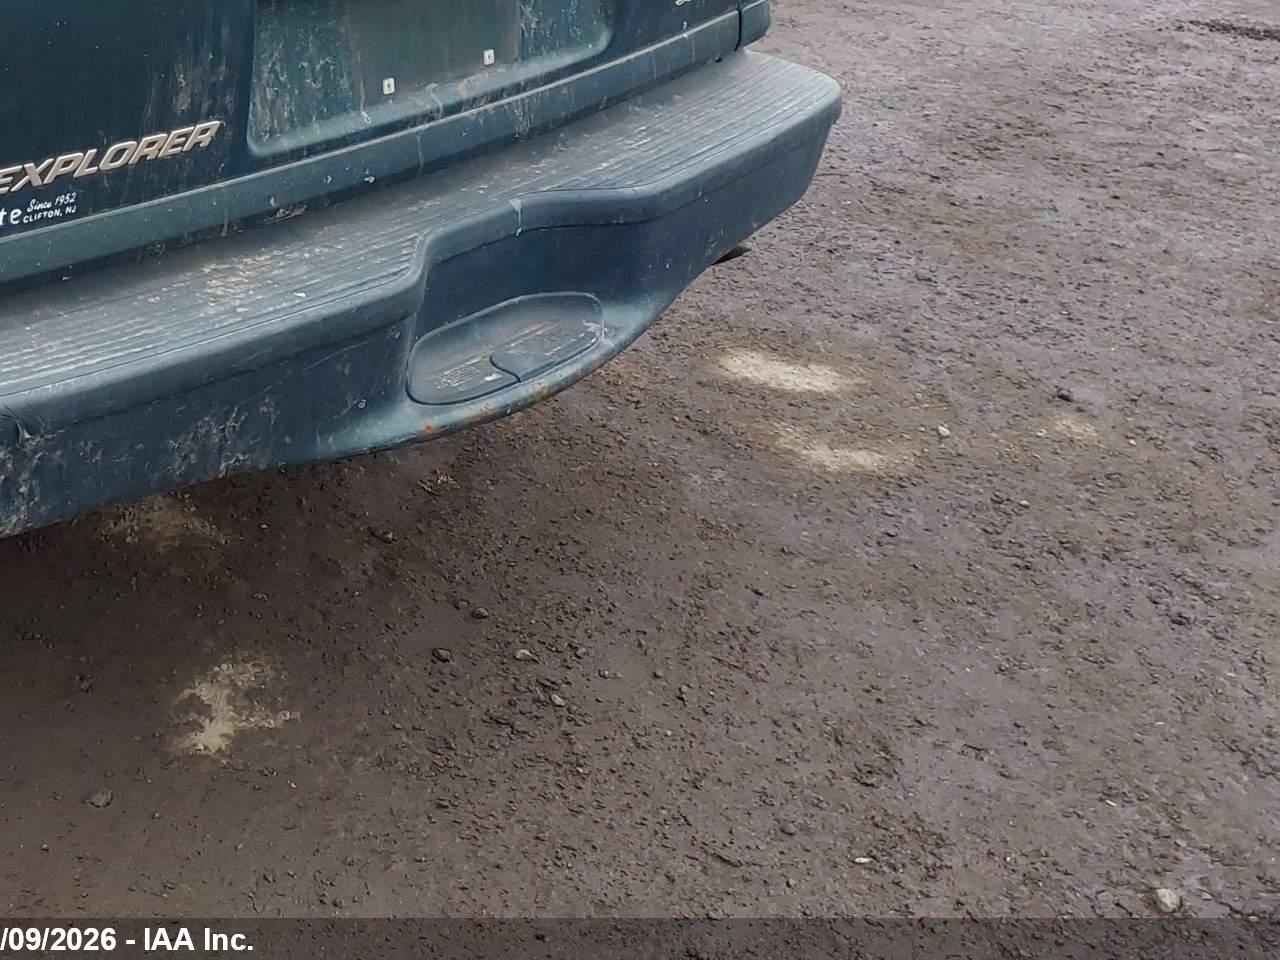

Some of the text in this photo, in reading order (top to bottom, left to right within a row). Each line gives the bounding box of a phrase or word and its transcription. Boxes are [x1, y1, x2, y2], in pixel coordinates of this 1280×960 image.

[26, 192, 78, 213] Since 1952
[22, 204, 78, 224] CLIFTON, NJ
